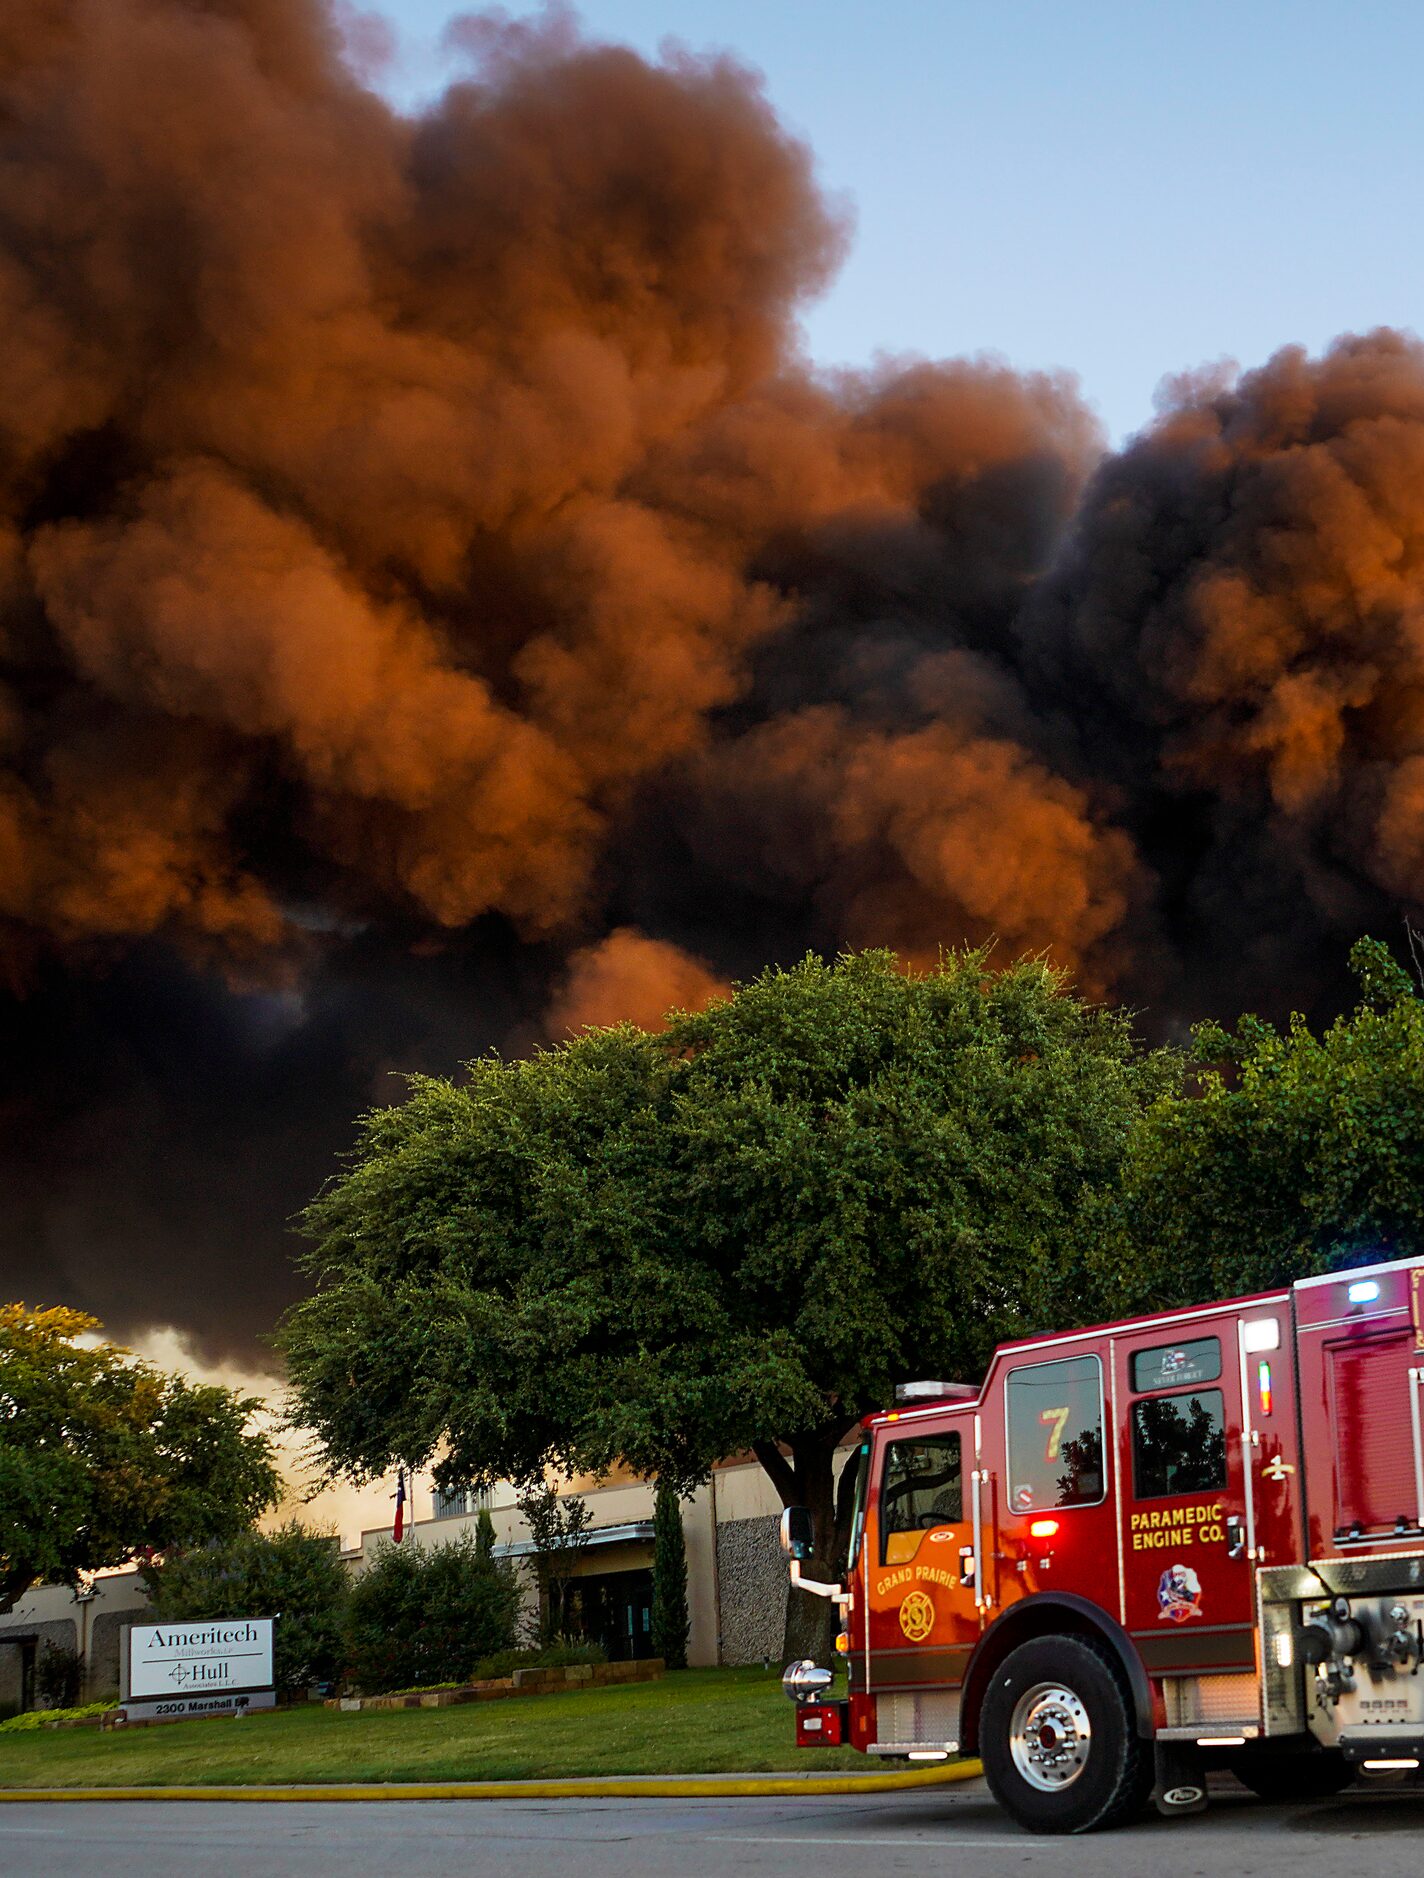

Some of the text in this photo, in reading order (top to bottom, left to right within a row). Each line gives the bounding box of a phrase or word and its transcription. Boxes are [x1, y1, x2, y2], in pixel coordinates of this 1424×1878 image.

[1040, 1407, 1069, 1461] 7
[1131, 1503, 1223, 1530] PARAMEDIC
[1132, 1524, 1225, 1550] ENGINE CO.
[877, 1566, 957, 1596] GRAND PRAIRIE
[148, 1623, 258, 1648] Ameritech
[192, 1662, 228, 1681] Hull
[156, 1703, 185, 1715] 2300
[188, 1698, 232, 1712] Marshall
